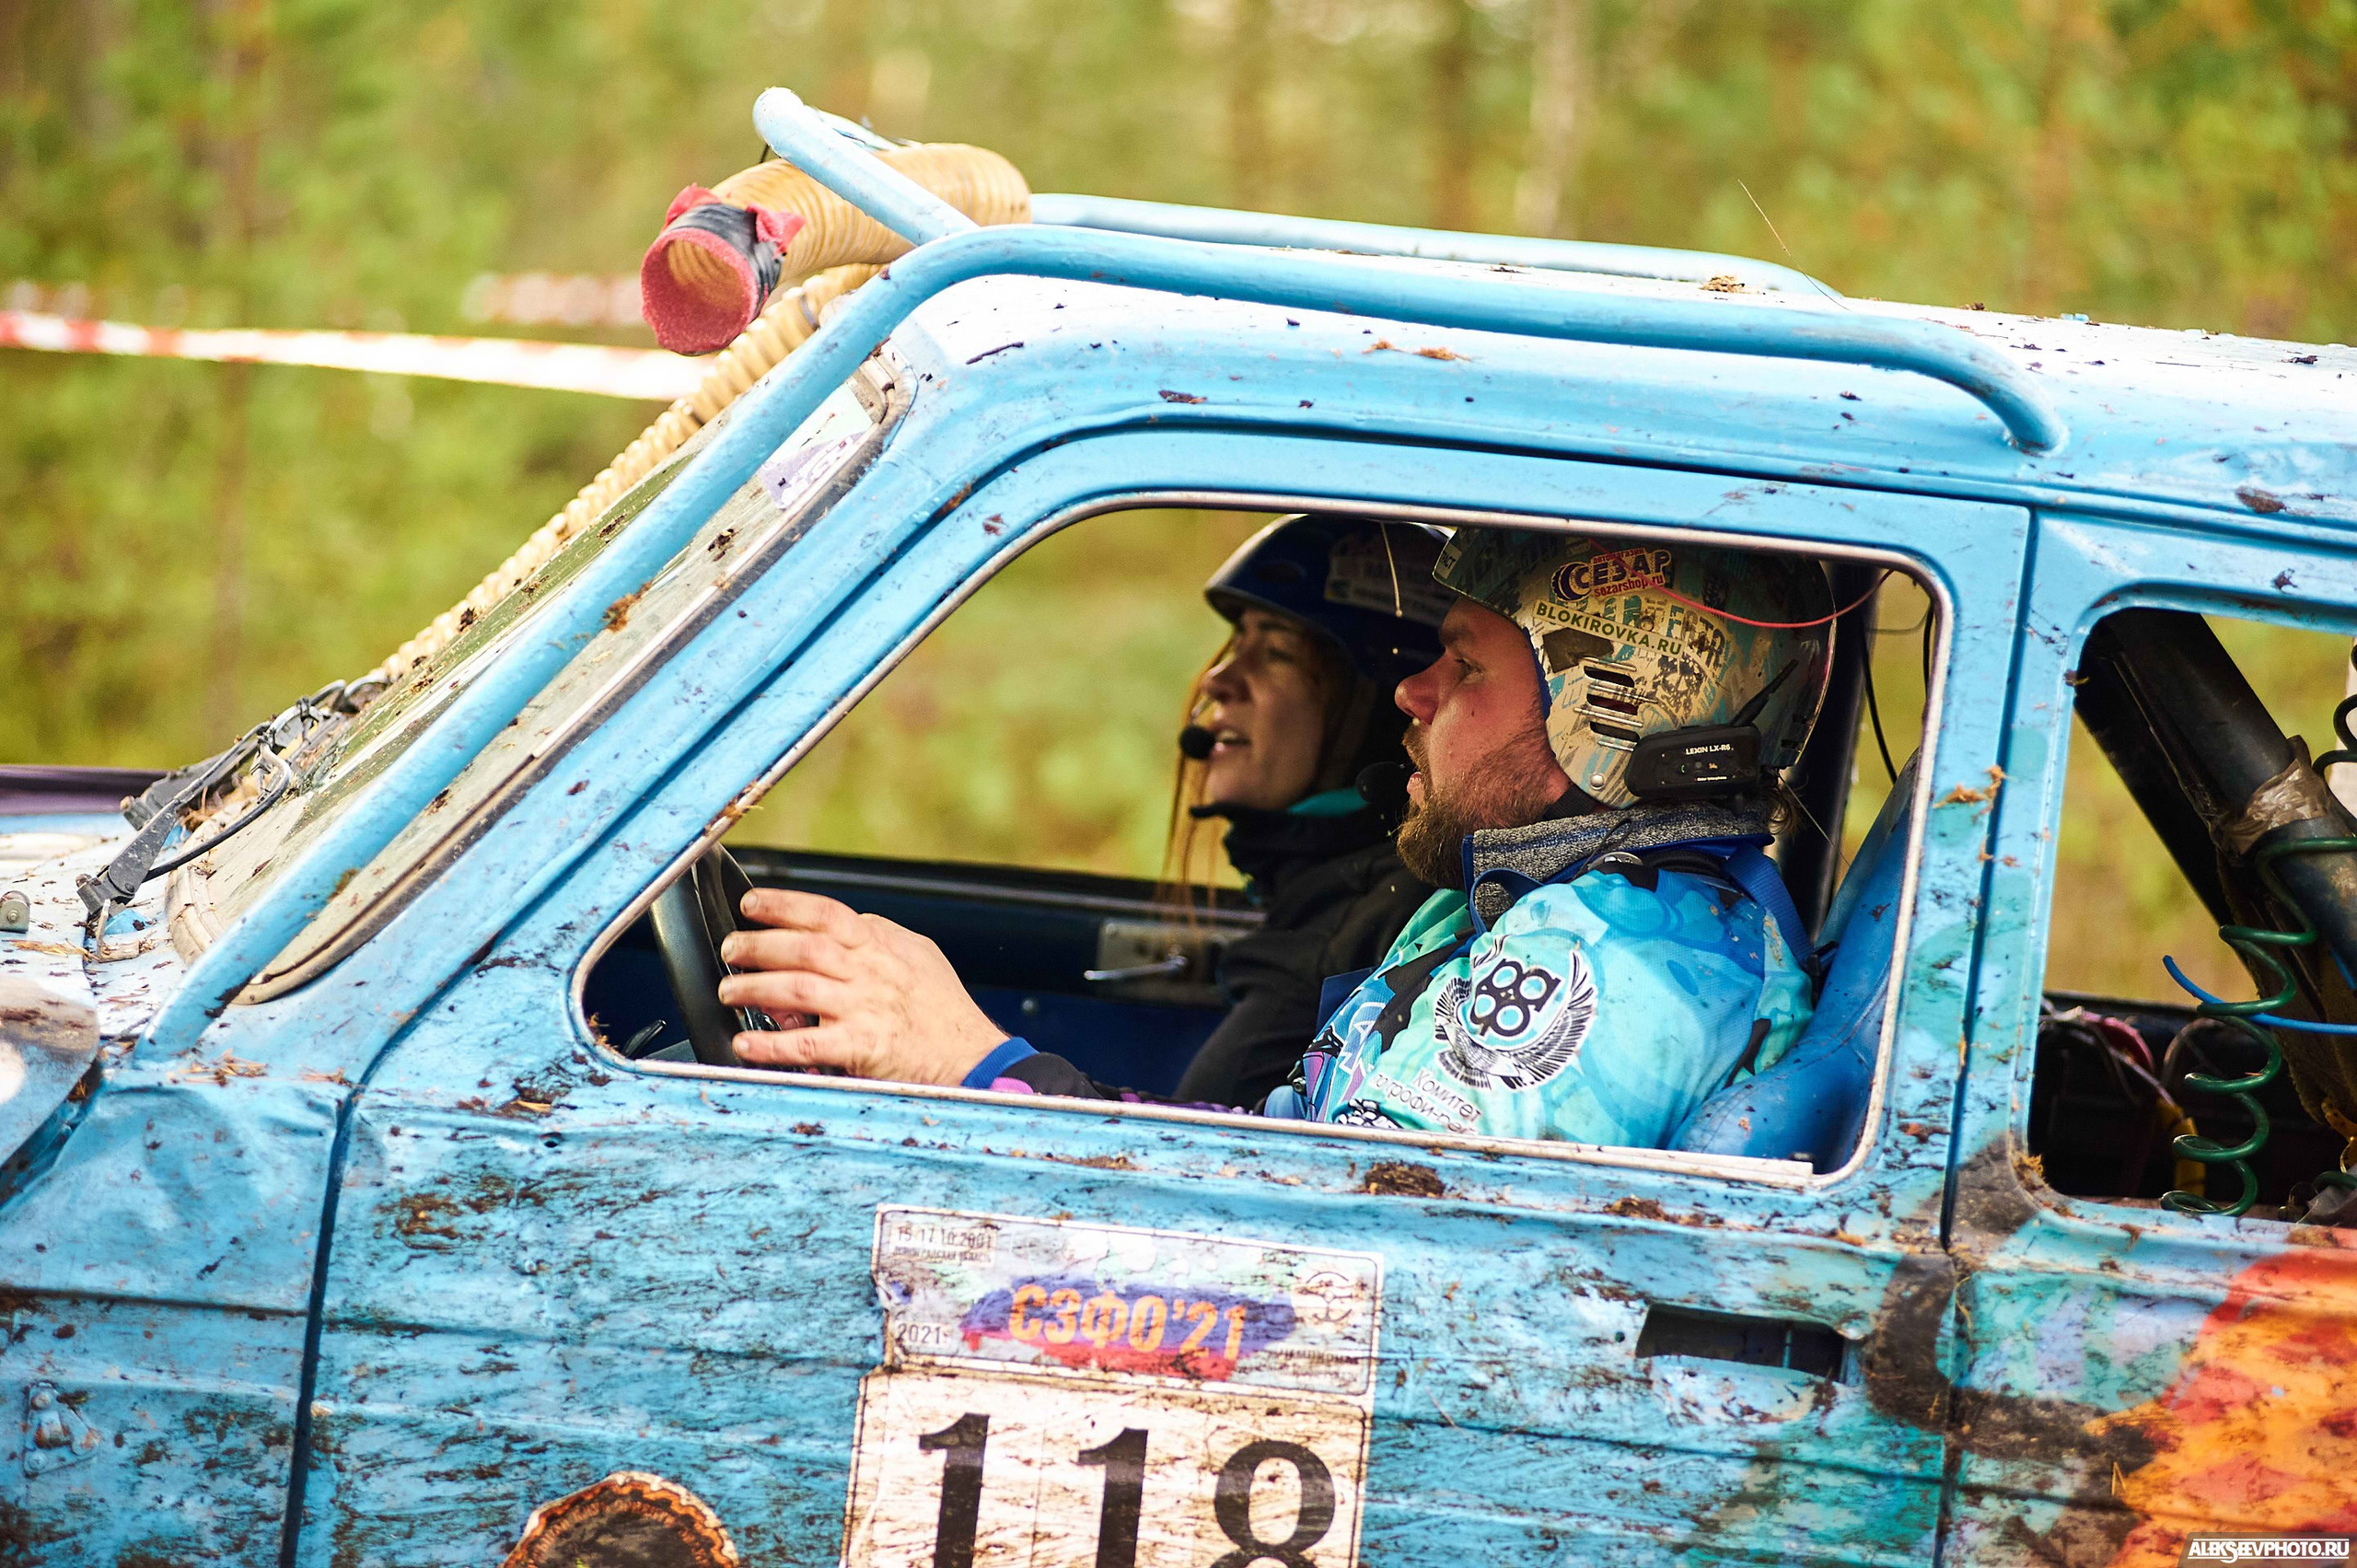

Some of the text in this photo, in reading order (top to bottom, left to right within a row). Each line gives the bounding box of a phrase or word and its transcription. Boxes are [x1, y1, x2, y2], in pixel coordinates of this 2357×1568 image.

[1574, 551, 1671, 589] СЕЗАР
[1594, 574, 1664, 598] sezarshopru
[1536, 601, 1682, 656] BLOKIROVKA.RU
[1686, 743, 1731, 755] LEXIN LX-R6
[1414, 1069, 1481, 1122] Комитет
[1008, 1283, 1247, 1361] СЗФО'21
[919, 1412, 1335, 1568] 118
